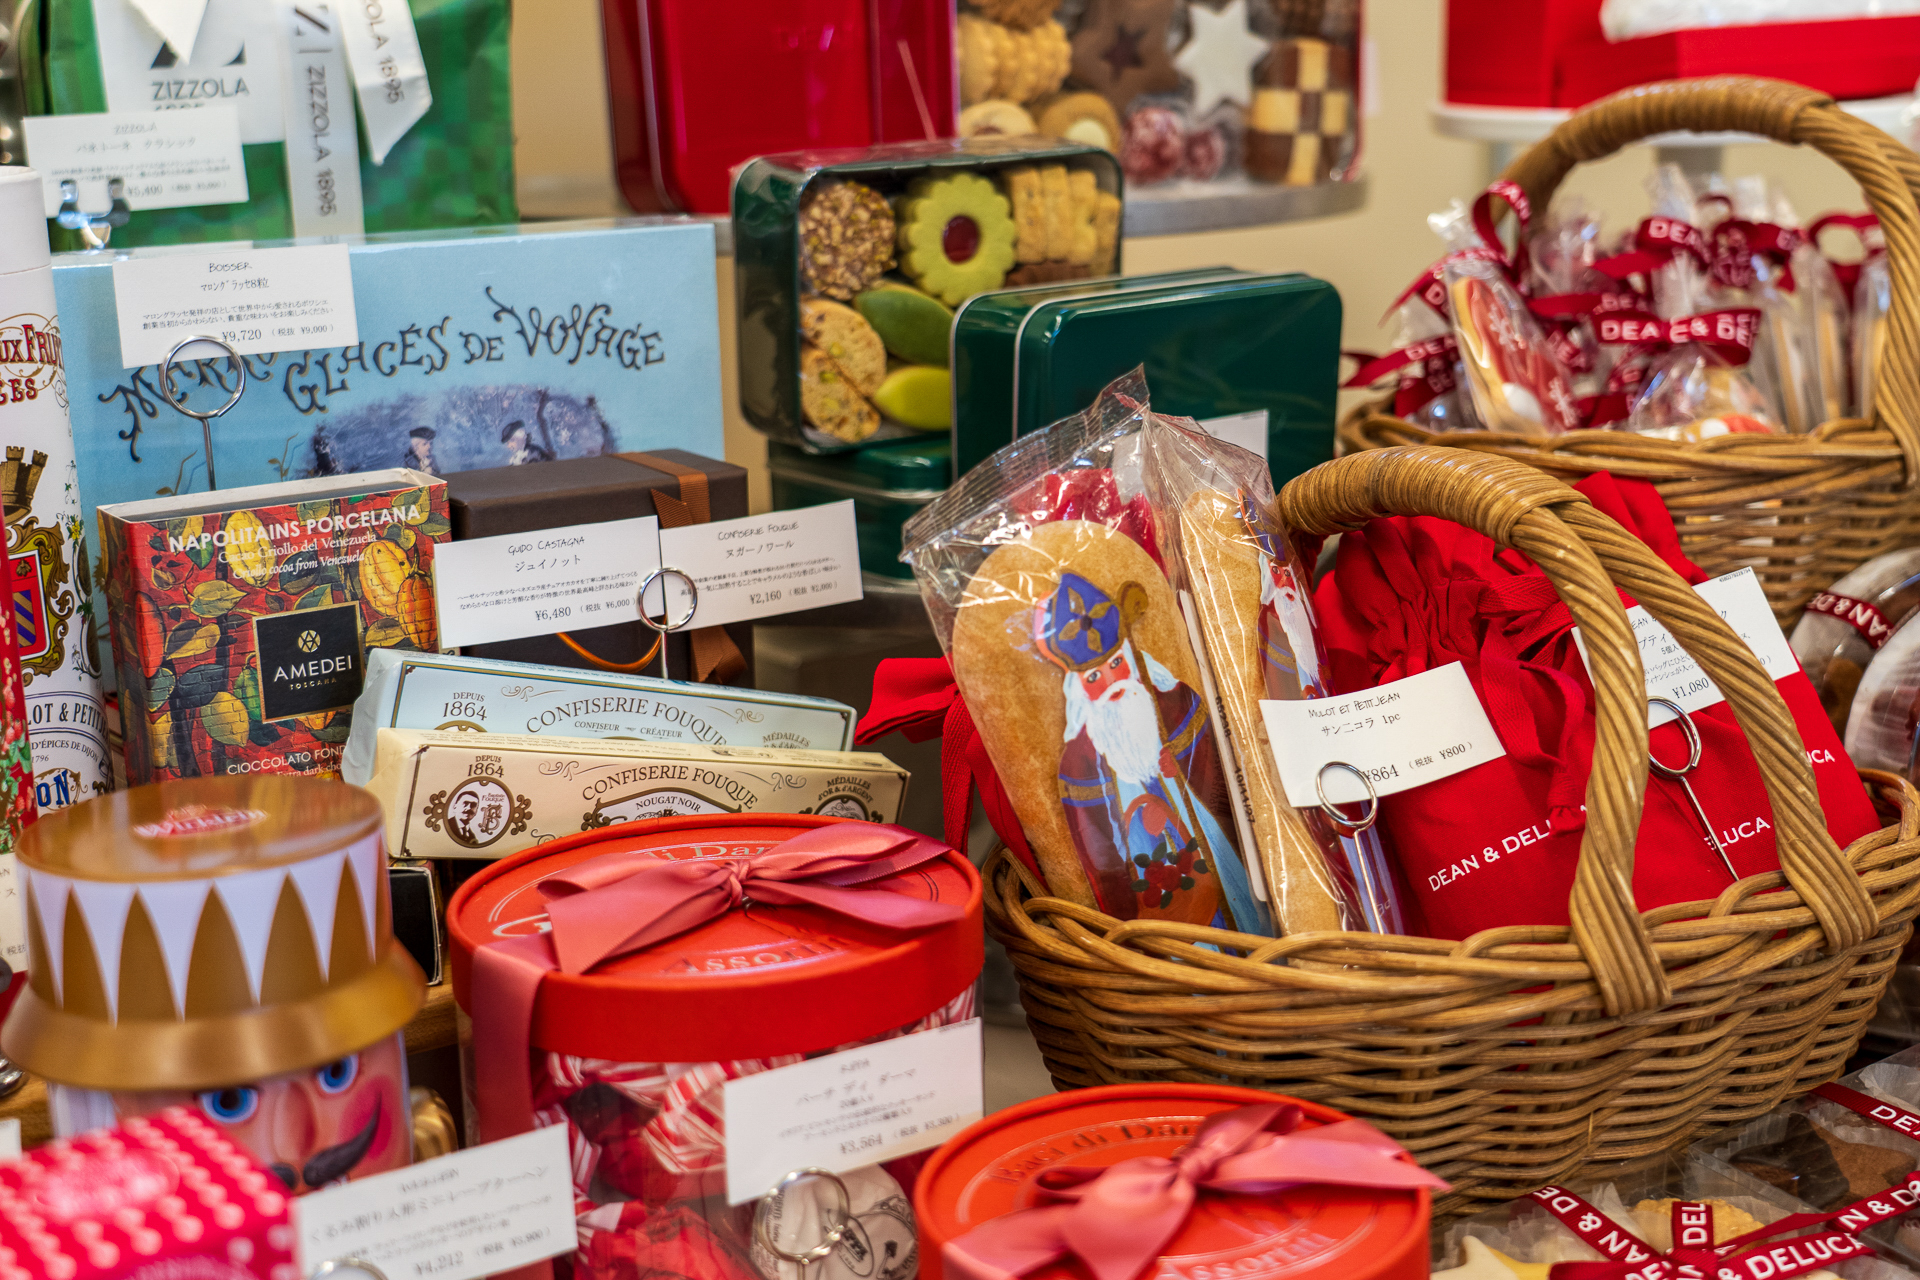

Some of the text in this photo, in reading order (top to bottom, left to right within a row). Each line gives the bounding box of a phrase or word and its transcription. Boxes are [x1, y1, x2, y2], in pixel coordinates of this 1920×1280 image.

[364, 0, 405, 105] OLA 1895
[150, 77, 250, 101] ZIZZOLA
[308, 64, 338, 218] ZIZZOLA 1895
[221, 329, 262, 343] ¥9,720
[459, 330, 505, 364] DE
[484, 286, 666, 371] VOYAGE
[168, 503, 421, 554] NAPOLITAINS PORCELANA
[217, 531, 378, 564] Cacao Criollo del Venezuela
[232, 549, 366, 580] Criollo cocoa from Venezuela
[514, 554, 582, 573] ジュイノット
[749, 589, 783, 605] ¥2,160
[534, 605, 573, 622] ¥6,480
[272, 654, 353, 683] AMEDEI
[289, 677, 338, 691] TOSCANA
[1671, 677, 1711, 700] ¥1,080
[452, 691, 486, 703] DEPUIS
[442, 700, 488, 722] 1864
[526, 695, 728, 746] CONFISERIE FOUQUE
[574, 720, 684, 739] CONFISEUR CRÉATEUR
[1320, 716, 1375, 738] サンニコラ
[70, 740, 82, 751] DE
[226, 751, 312, 776] CIOCCOLATO
[475, 754, 503, 765] DEPUIS
[467, 763, 505, 779] 1864
[1362, 763, 1400, 784] ¥864
[581, 765, 759, 810] CONFISERIE FOUQUE
[826, 775, 872, 790] MÉDAILLES
[635, 795, 702, 813] NOUGAT NOIR
[1426, 853, 1481, 892] DEAN
[1482, 845, 1501, 864] &
[1866, 1200, 1896, 1216] &
[1577, 1211, 1603, 1233] &
